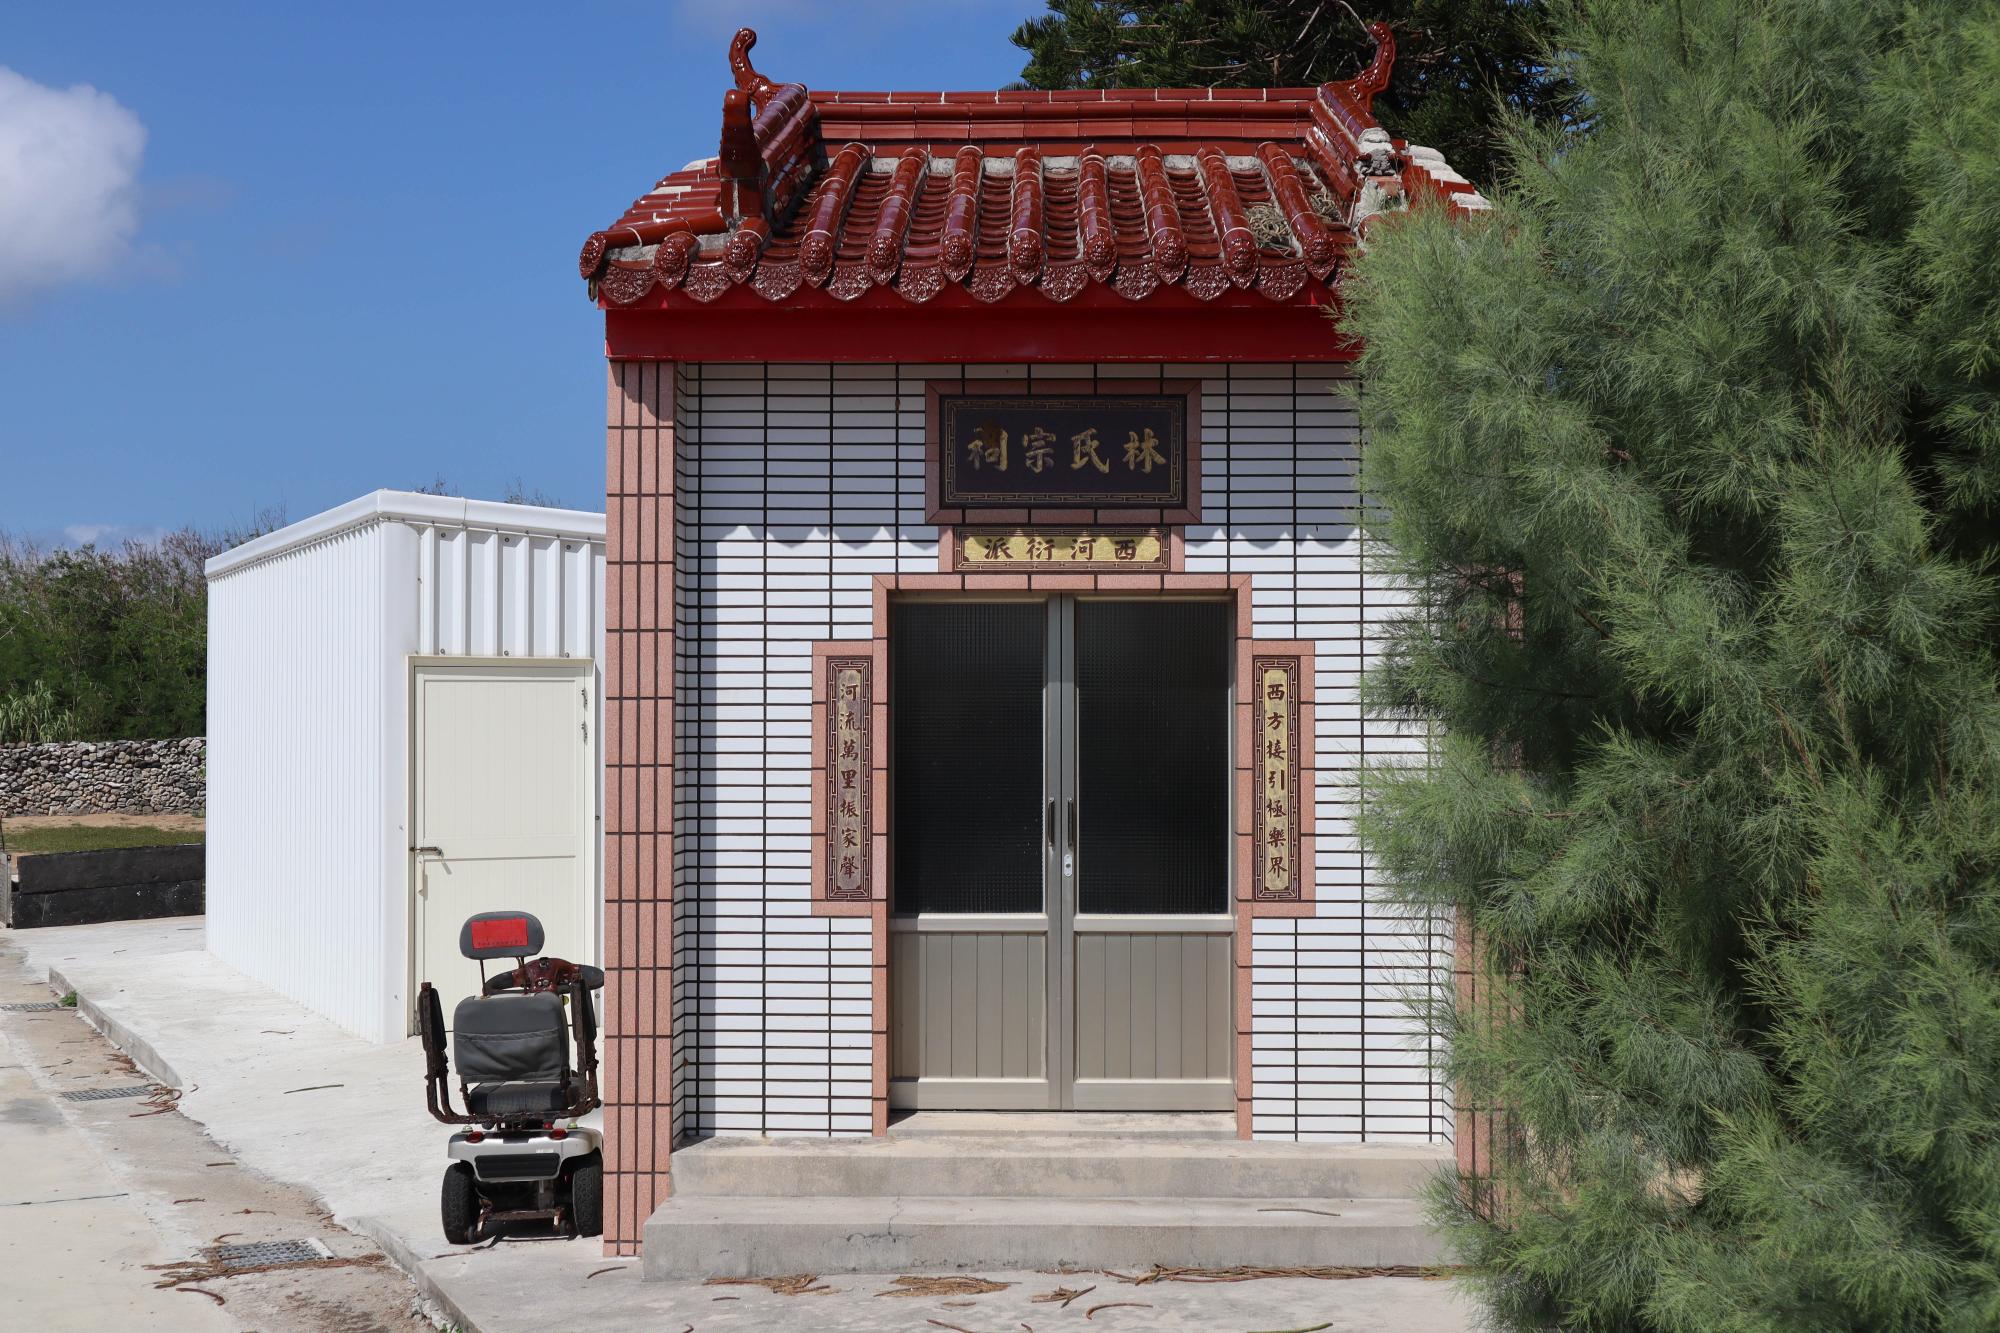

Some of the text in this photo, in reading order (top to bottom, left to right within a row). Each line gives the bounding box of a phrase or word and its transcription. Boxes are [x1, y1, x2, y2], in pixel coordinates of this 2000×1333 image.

[967, 426, 1167, 474] 林氏宗祠
[983, 536, 1137, 561] 西河衍派
[839, 682, 861, 881] 河流萬里振家聲
[1266, 683, 1288, 880] 西方接引極樂界
